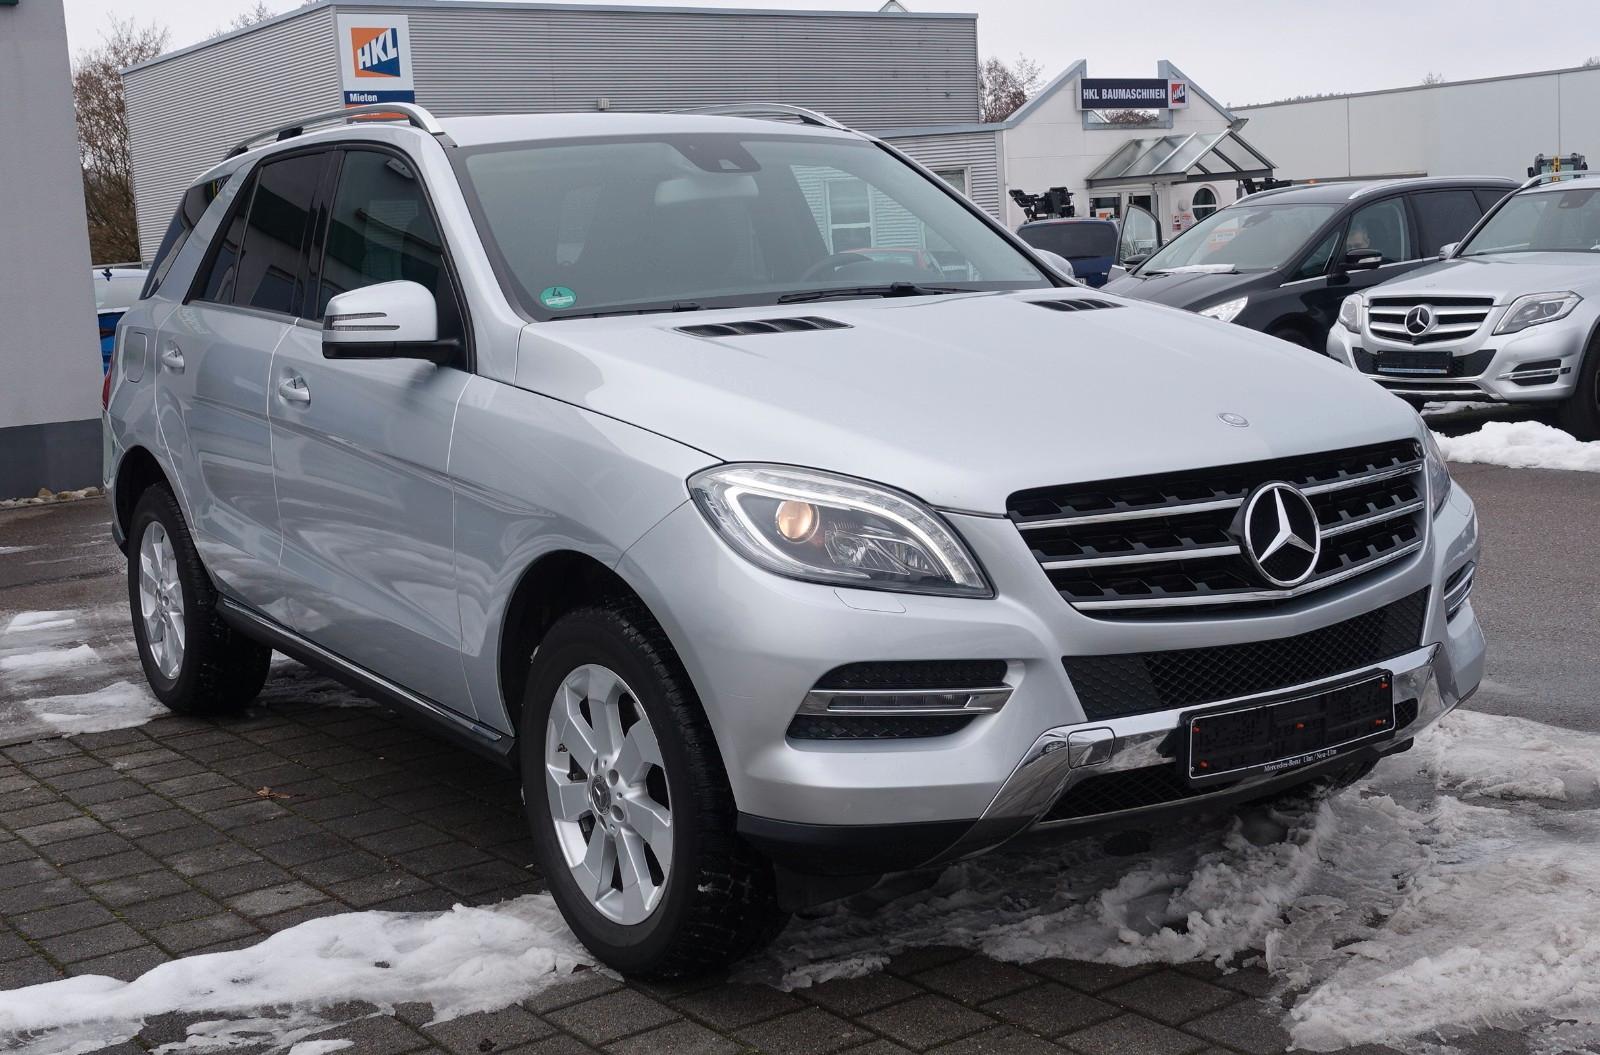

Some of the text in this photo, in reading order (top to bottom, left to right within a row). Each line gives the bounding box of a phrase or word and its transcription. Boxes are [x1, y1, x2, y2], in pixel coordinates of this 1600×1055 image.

[357, 28, 397, 69] HKL
[349, 93, 378, 102] Mieten
[1083, 89, 1165, 99] HKL BAUMASCHINEN
[1172, 84, 1185, 100] HKL
[1264, 760, 1300, 771] Mercedes-Benz
